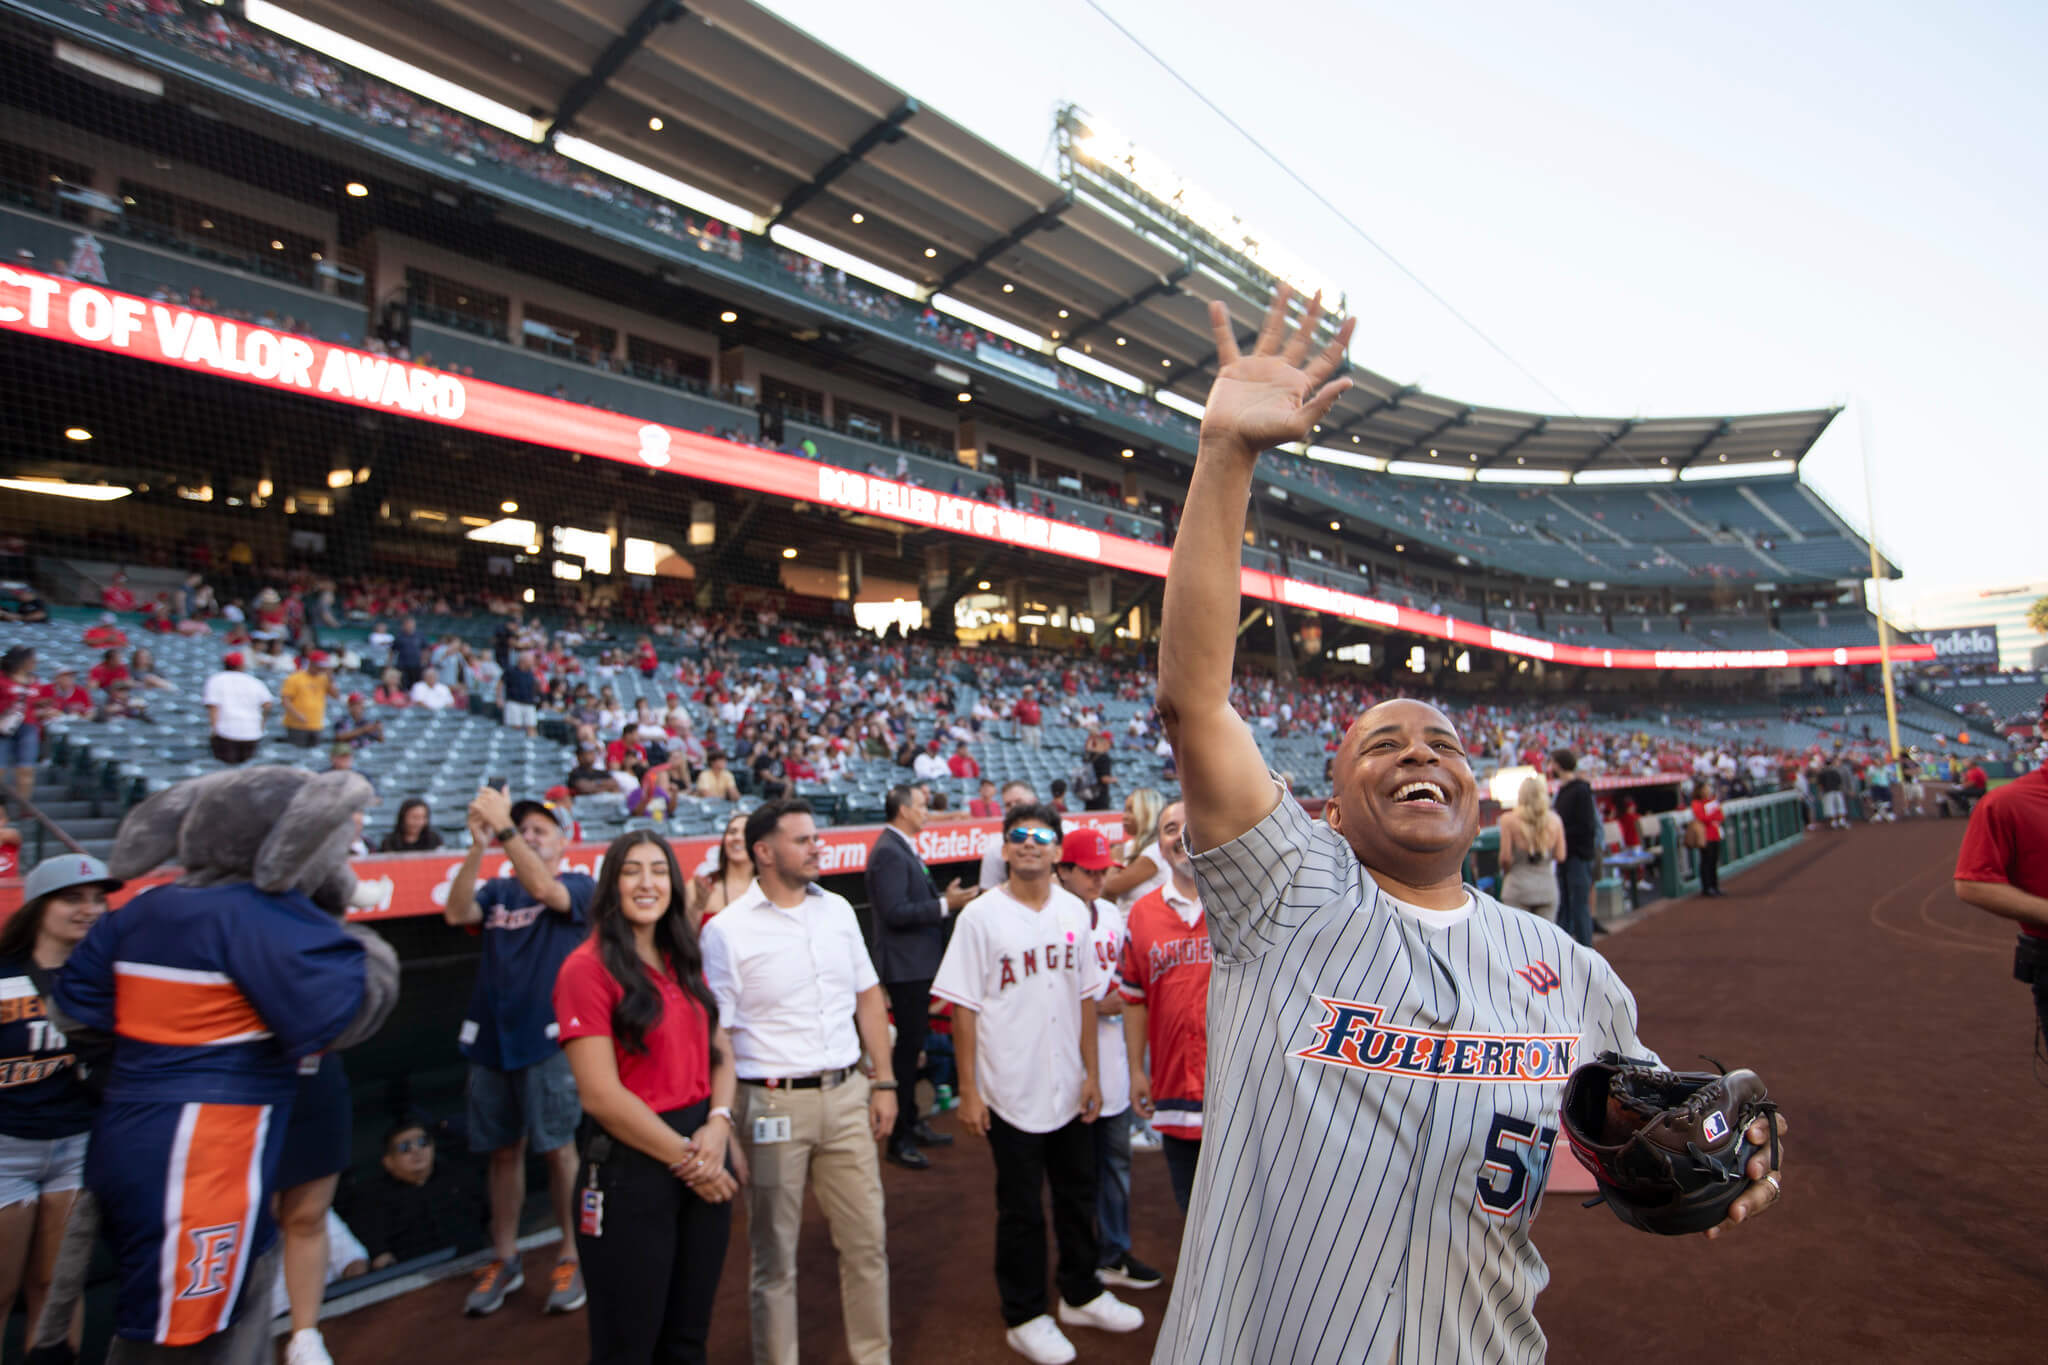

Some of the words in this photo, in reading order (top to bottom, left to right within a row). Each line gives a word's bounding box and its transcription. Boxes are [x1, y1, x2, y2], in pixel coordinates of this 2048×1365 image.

[68, 288, 145, 347] OF
[152, 306, 314, 388] VALOR
[318, 349, 466, 420] AWARD
[868, 478, 937, 524] FELLER
[936, 495, 973, 531] ACT
[1000, 943, 1082, 990] ANGE
[1312, 1003, 1573, 1079] FULLERTON
[178, 1222, 240, 1300] F
